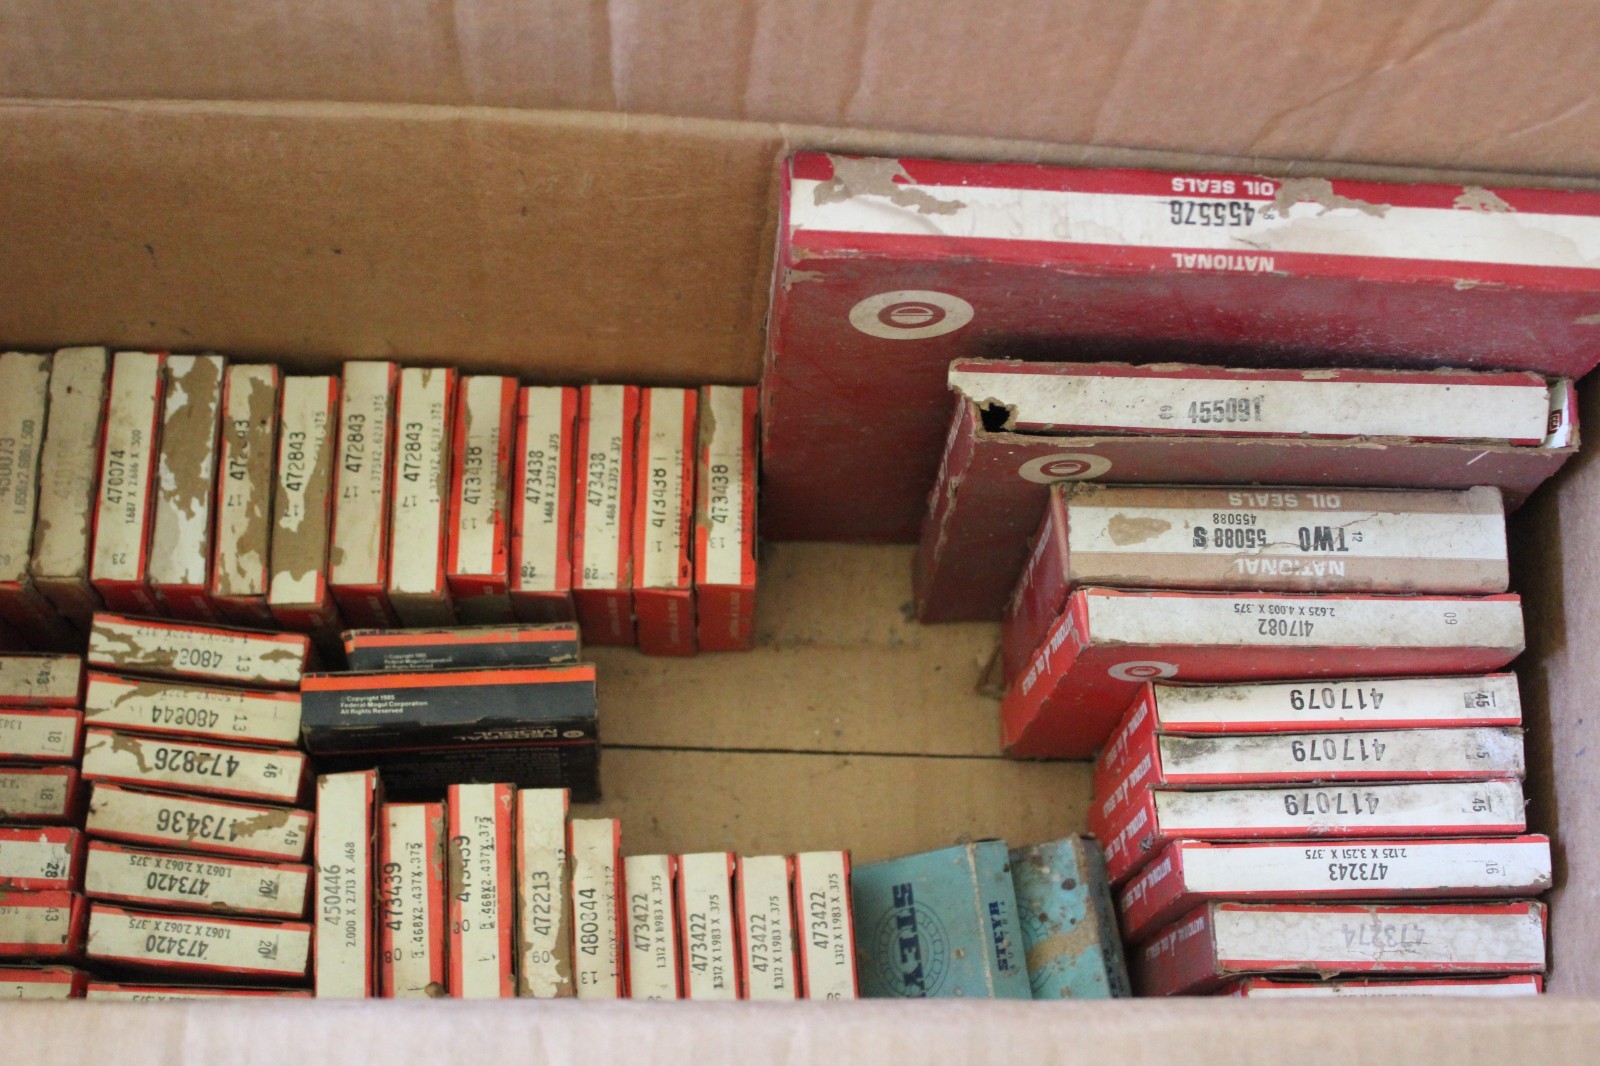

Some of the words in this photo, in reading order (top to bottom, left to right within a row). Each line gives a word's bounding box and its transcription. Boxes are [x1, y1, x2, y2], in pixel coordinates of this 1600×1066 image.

[1171, 177, 1235, 194] SEALS
[1241, 179, 1274, 195] OIL
[1169, 200, 1256, 227] 455576
[1171, 252, 1274, 272] NATIONAL
[345, 414, 365, 473] 472843
[404, 422, 423, 482] 472843
[548, 434, 560, 452] .375
[610, 437, 622, 455] .375
[286, 432, 306, 491] 472843
[107, 450, 126, 504] 470074
[464, 447, 482, 505] 473438
[526, 450, 544, 504] 473438
[545, 465, 557, 488] 2.375
[588, 453, 605, 507] 473438
[608, 467, 619, 491] 2.375
[711, 465, 728, 524] 473438
[1228, 492, 1298, 508] SEALS
[1305, 493, 1340, 509] OIL
[544, 502, 555, 524] 1.468
[605, 504, 616, 526] 1.468
[1212, 512, 1257, 526] 455088
[1193, 526, 1207, 548] S
[1214, 526, 1267, 550] 55088
[1297, 525, 1349, 552] TWO
[1235, 558, 1345, 577] NATIONAL
[1234, 602, 1255, 614] .375
[1258, 603, 1264, 614] X
[1268, 604, 1295, 616] 4.003
[1298, 605, 1305, 615] X
[1308, 606, 1336, 617] 2.625
[1257, 617, 1314, 637] 417082
[347, 695, 379, 703] Copyright
[1289, 687, 1384, 710] 417079
[1291, 738, 1386, 762] 417079
[155, 748, 239, 777] 472826
[1284, 792, 1380, 815] 417079
[157, 808, 237, 842] 473436
[130, 856, 150, 869] .375
[345, 842, 355, 862] .468
[1305, 849, 1326, 860] .375
[1330, 850, 1337, 859] X
[1341, 848, 1367, 859] 3.251
[1371, 849, 1378, 858] X
[1382, 848, 1407, 859] 2.125
[153, 858, 161, 869] X
[165, 859, 193, 874] 2.062
[196, 863, 203, 874] X
[207, 865, 232, 877] 1.062
[1328, 862, 1388, 881] 473243
[147, 872, 209, 895] 473420
[346, 880, 356, 903] 2.713
[652, 875, 662, 895] .375
[829, 874, 839, 892] .375
[323, 865, 341, 925] 450446
[384, 863, 403, 931] 473439
[532, 871, 550, 935] 472213
[710, 895, 720, 914] .375
[770, 896, 780, 915] .375
[129, 918, 150, 931] .375
[153, 921, 161, 932] X
[164, 922, 192, 935] 2.062
[579, 888, 598, 955] 480844
[632, 893, 651, 952] 473422
[810, 891, 829, 949] 473422
[833, 907, 842, 930] 1.983
[195, 925, 202, 936] X
[206, 927, 231, 939] 1.062
[346, 920, 356, 947] 2.000
[712, 928, 721, 952] 1.983
[772, 929, 782, 952] 1.983
[893, 883, 926, 998] STEY
[988, 901, 1008, 971] STEYR
[145, 935, 208, 958] 473420
[690, 913, 708, 971] 473422
[751, 914, 769, 972] 473422
[656, 947, 666, 968] 1.312
[834, 944, 845, 965] 1.312
[713, 966, 723, 989] 1.312
[774, 967, 784, 989] 1.312
